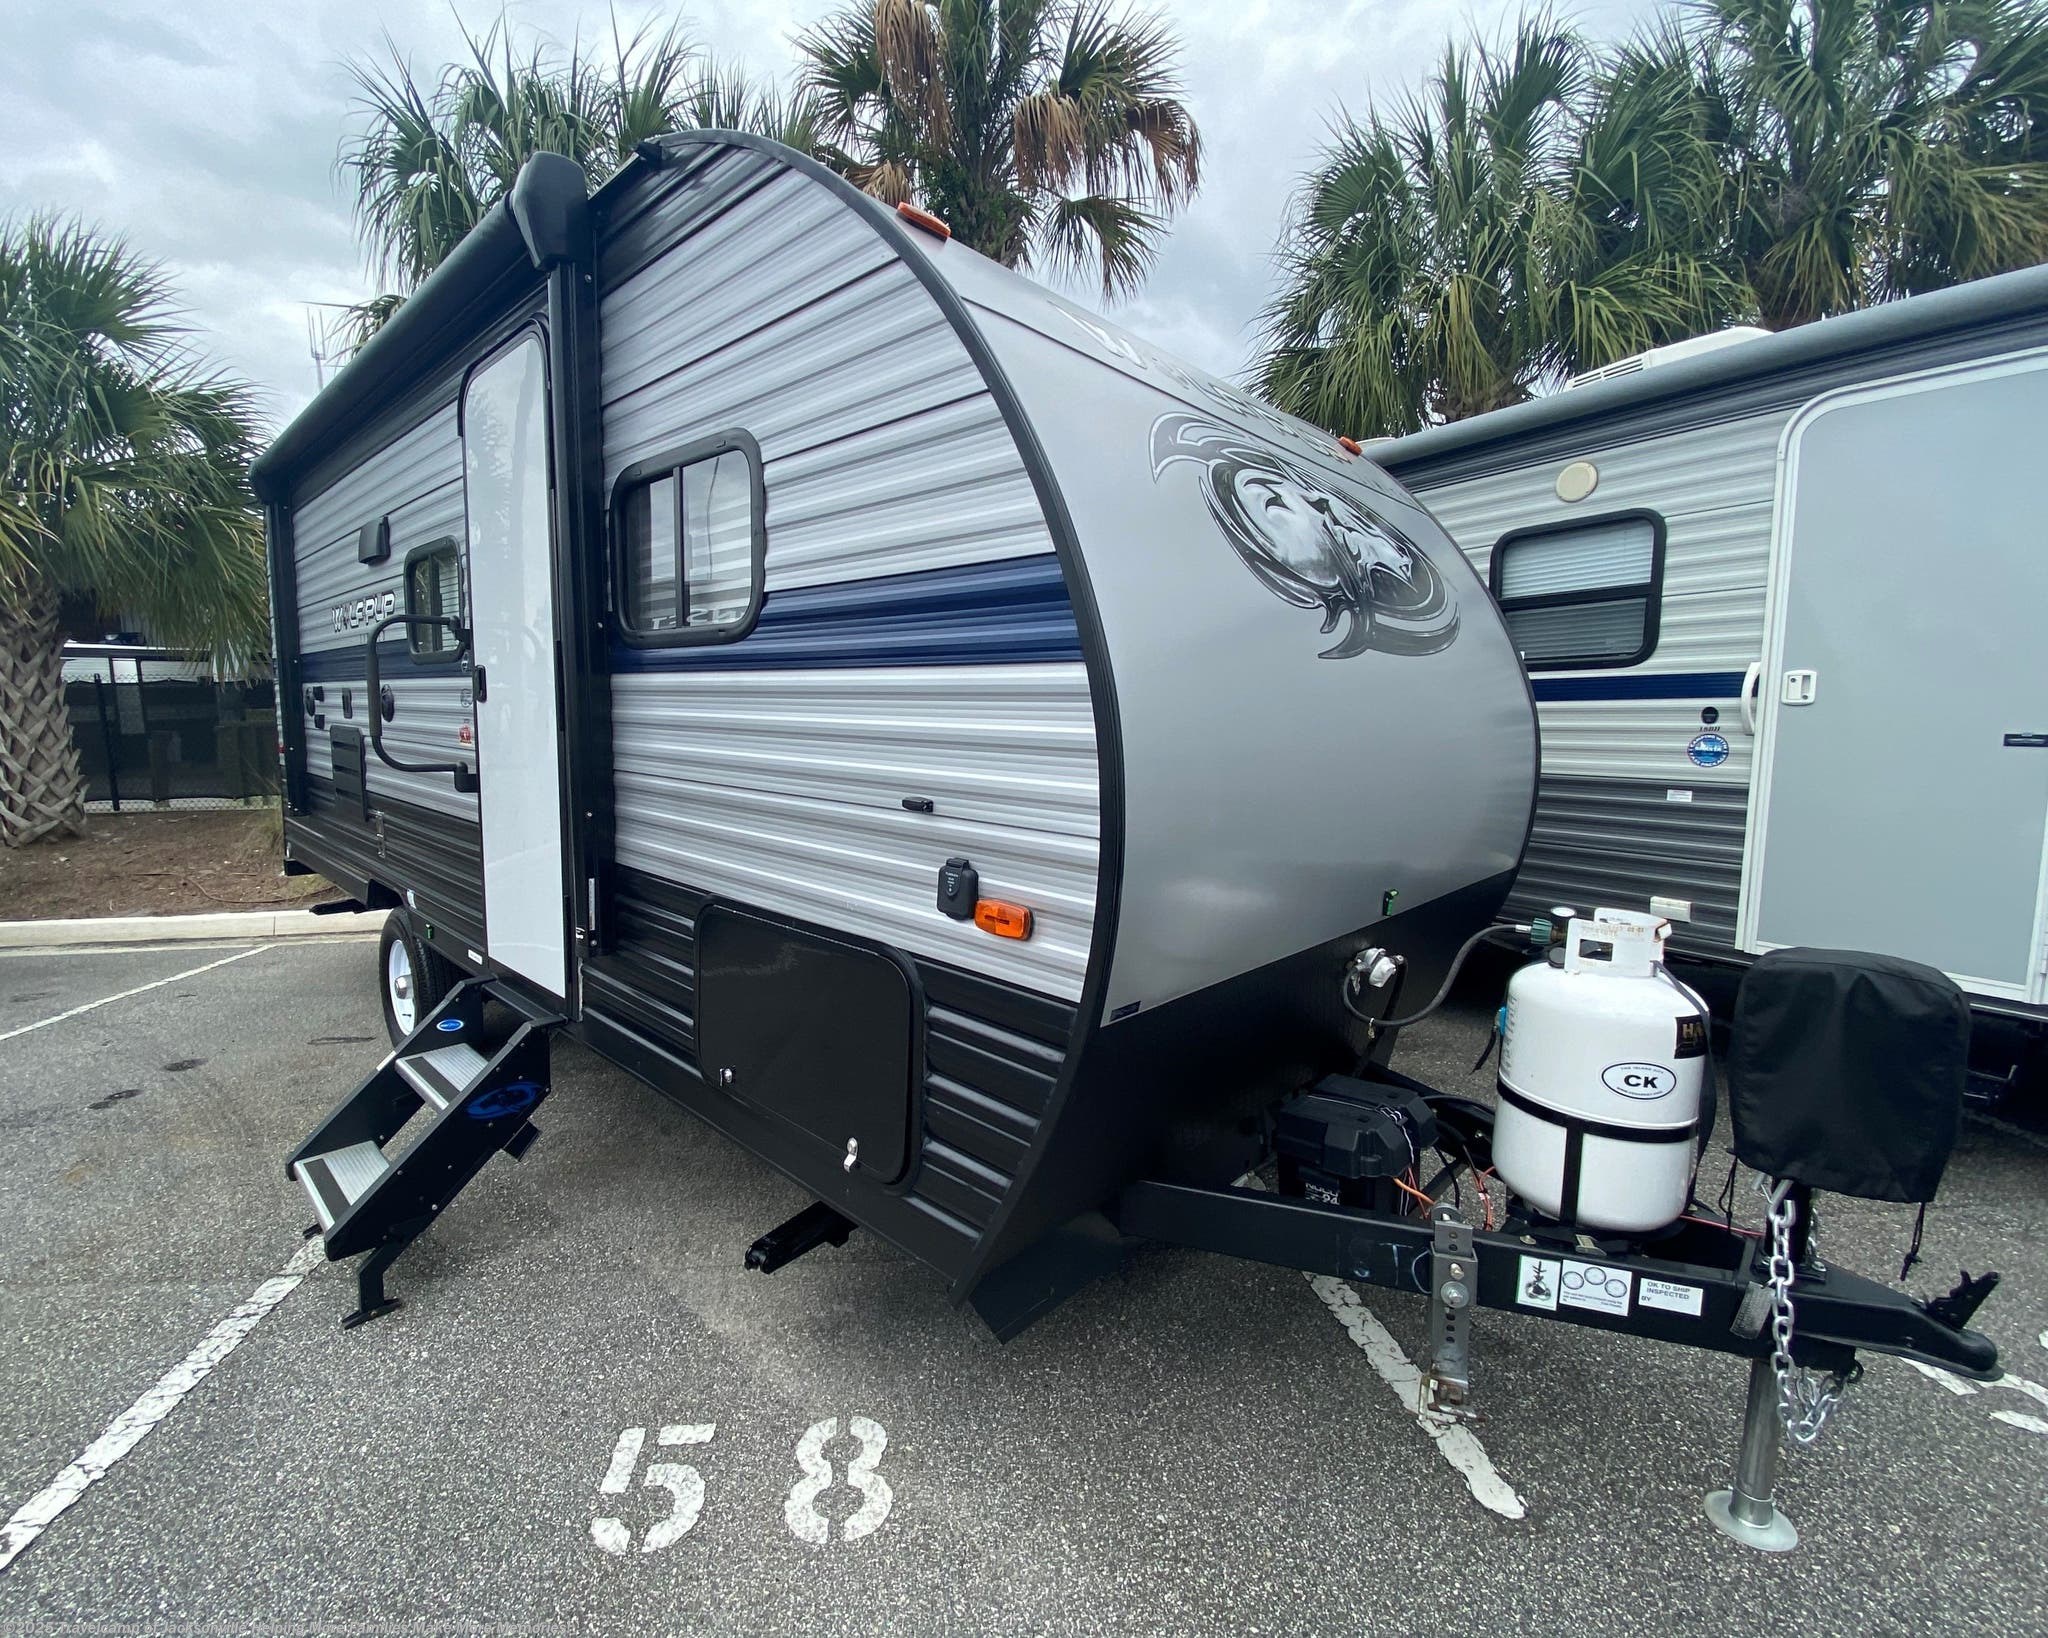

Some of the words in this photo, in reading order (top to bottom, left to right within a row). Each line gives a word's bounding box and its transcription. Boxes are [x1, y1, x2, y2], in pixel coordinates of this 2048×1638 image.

[1623, 1074, 1659, 1089] CK
[1647, 1281, 1659, 1289] OK
[1646, 1287, 1690, 1300] INSPECTED
